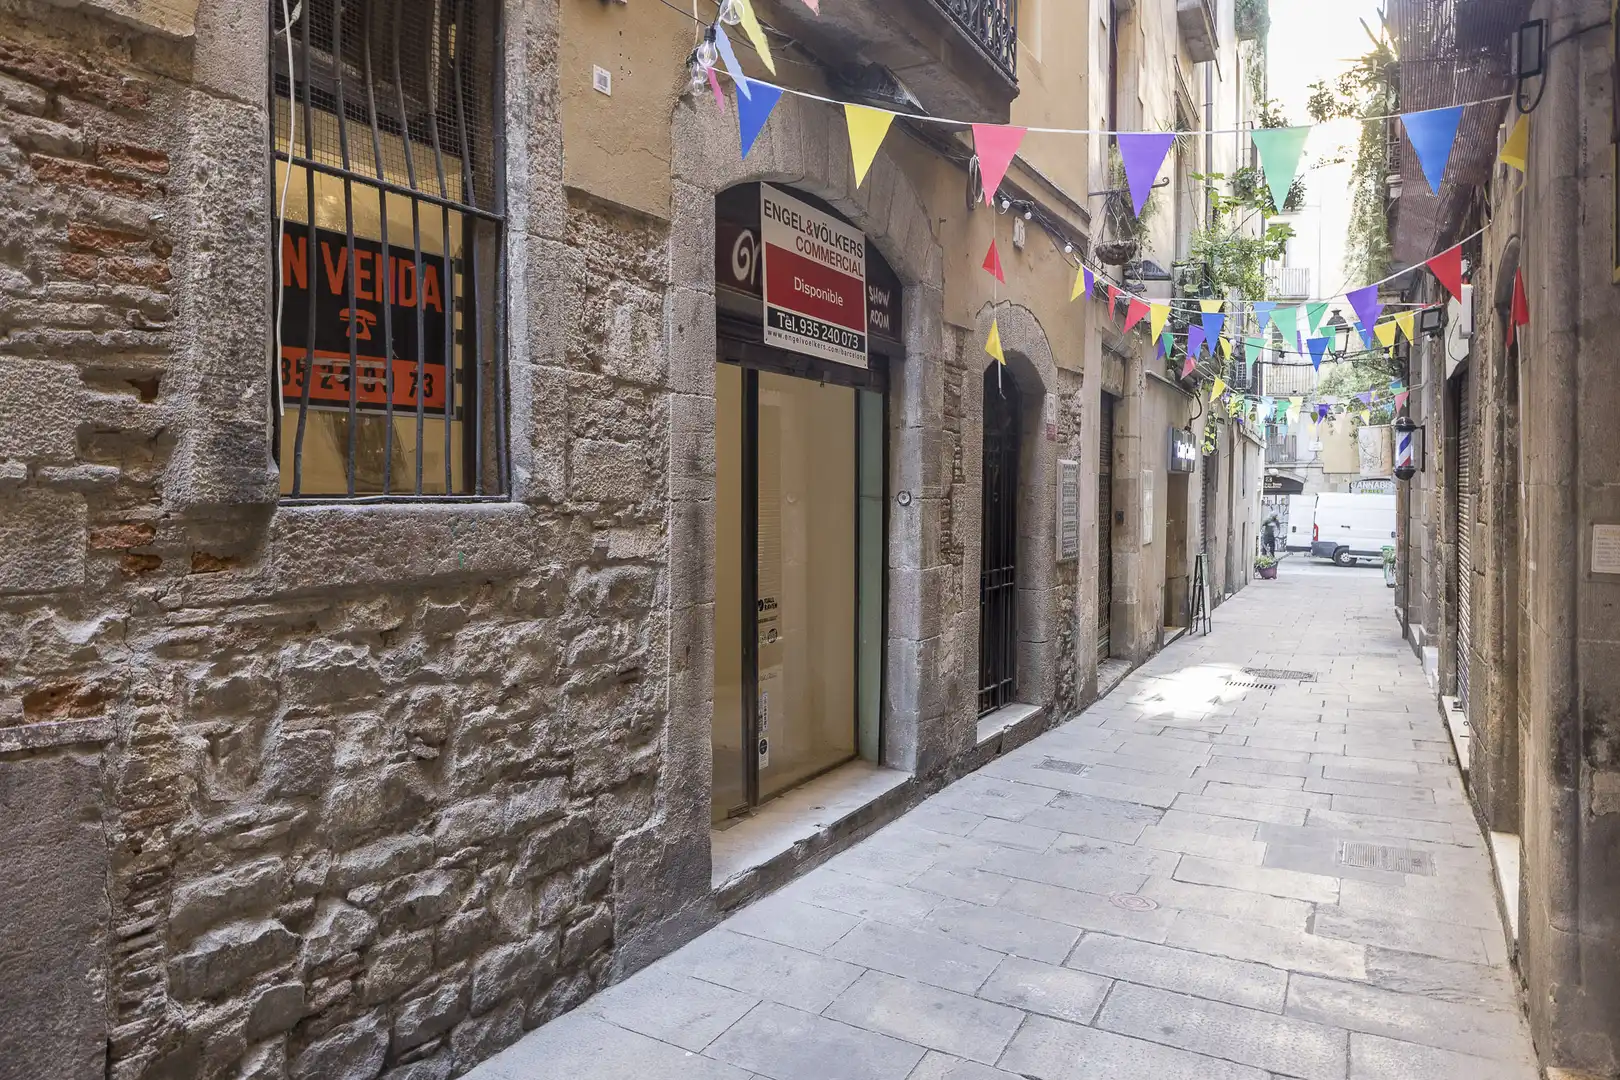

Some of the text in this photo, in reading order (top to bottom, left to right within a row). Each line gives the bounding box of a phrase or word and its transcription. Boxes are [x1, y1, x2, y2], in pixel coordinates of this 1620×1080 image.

[763, 198, 864, 259] ENGEL&VÖLKERS
[795, 236, 864, 278] COMMERCIAL
[321, 241, 443, 313] VENDA
[793, 276, 844, 307] Disponible
[868, 285, 890, 308] SHOW
[799, 318, 820, 337] 935
[821, 325, 840, 344] 240
[841, 331, 859, 349] 073
[870, 309, 890, 330] ROOM
[409, 370, 434, 398] 73
